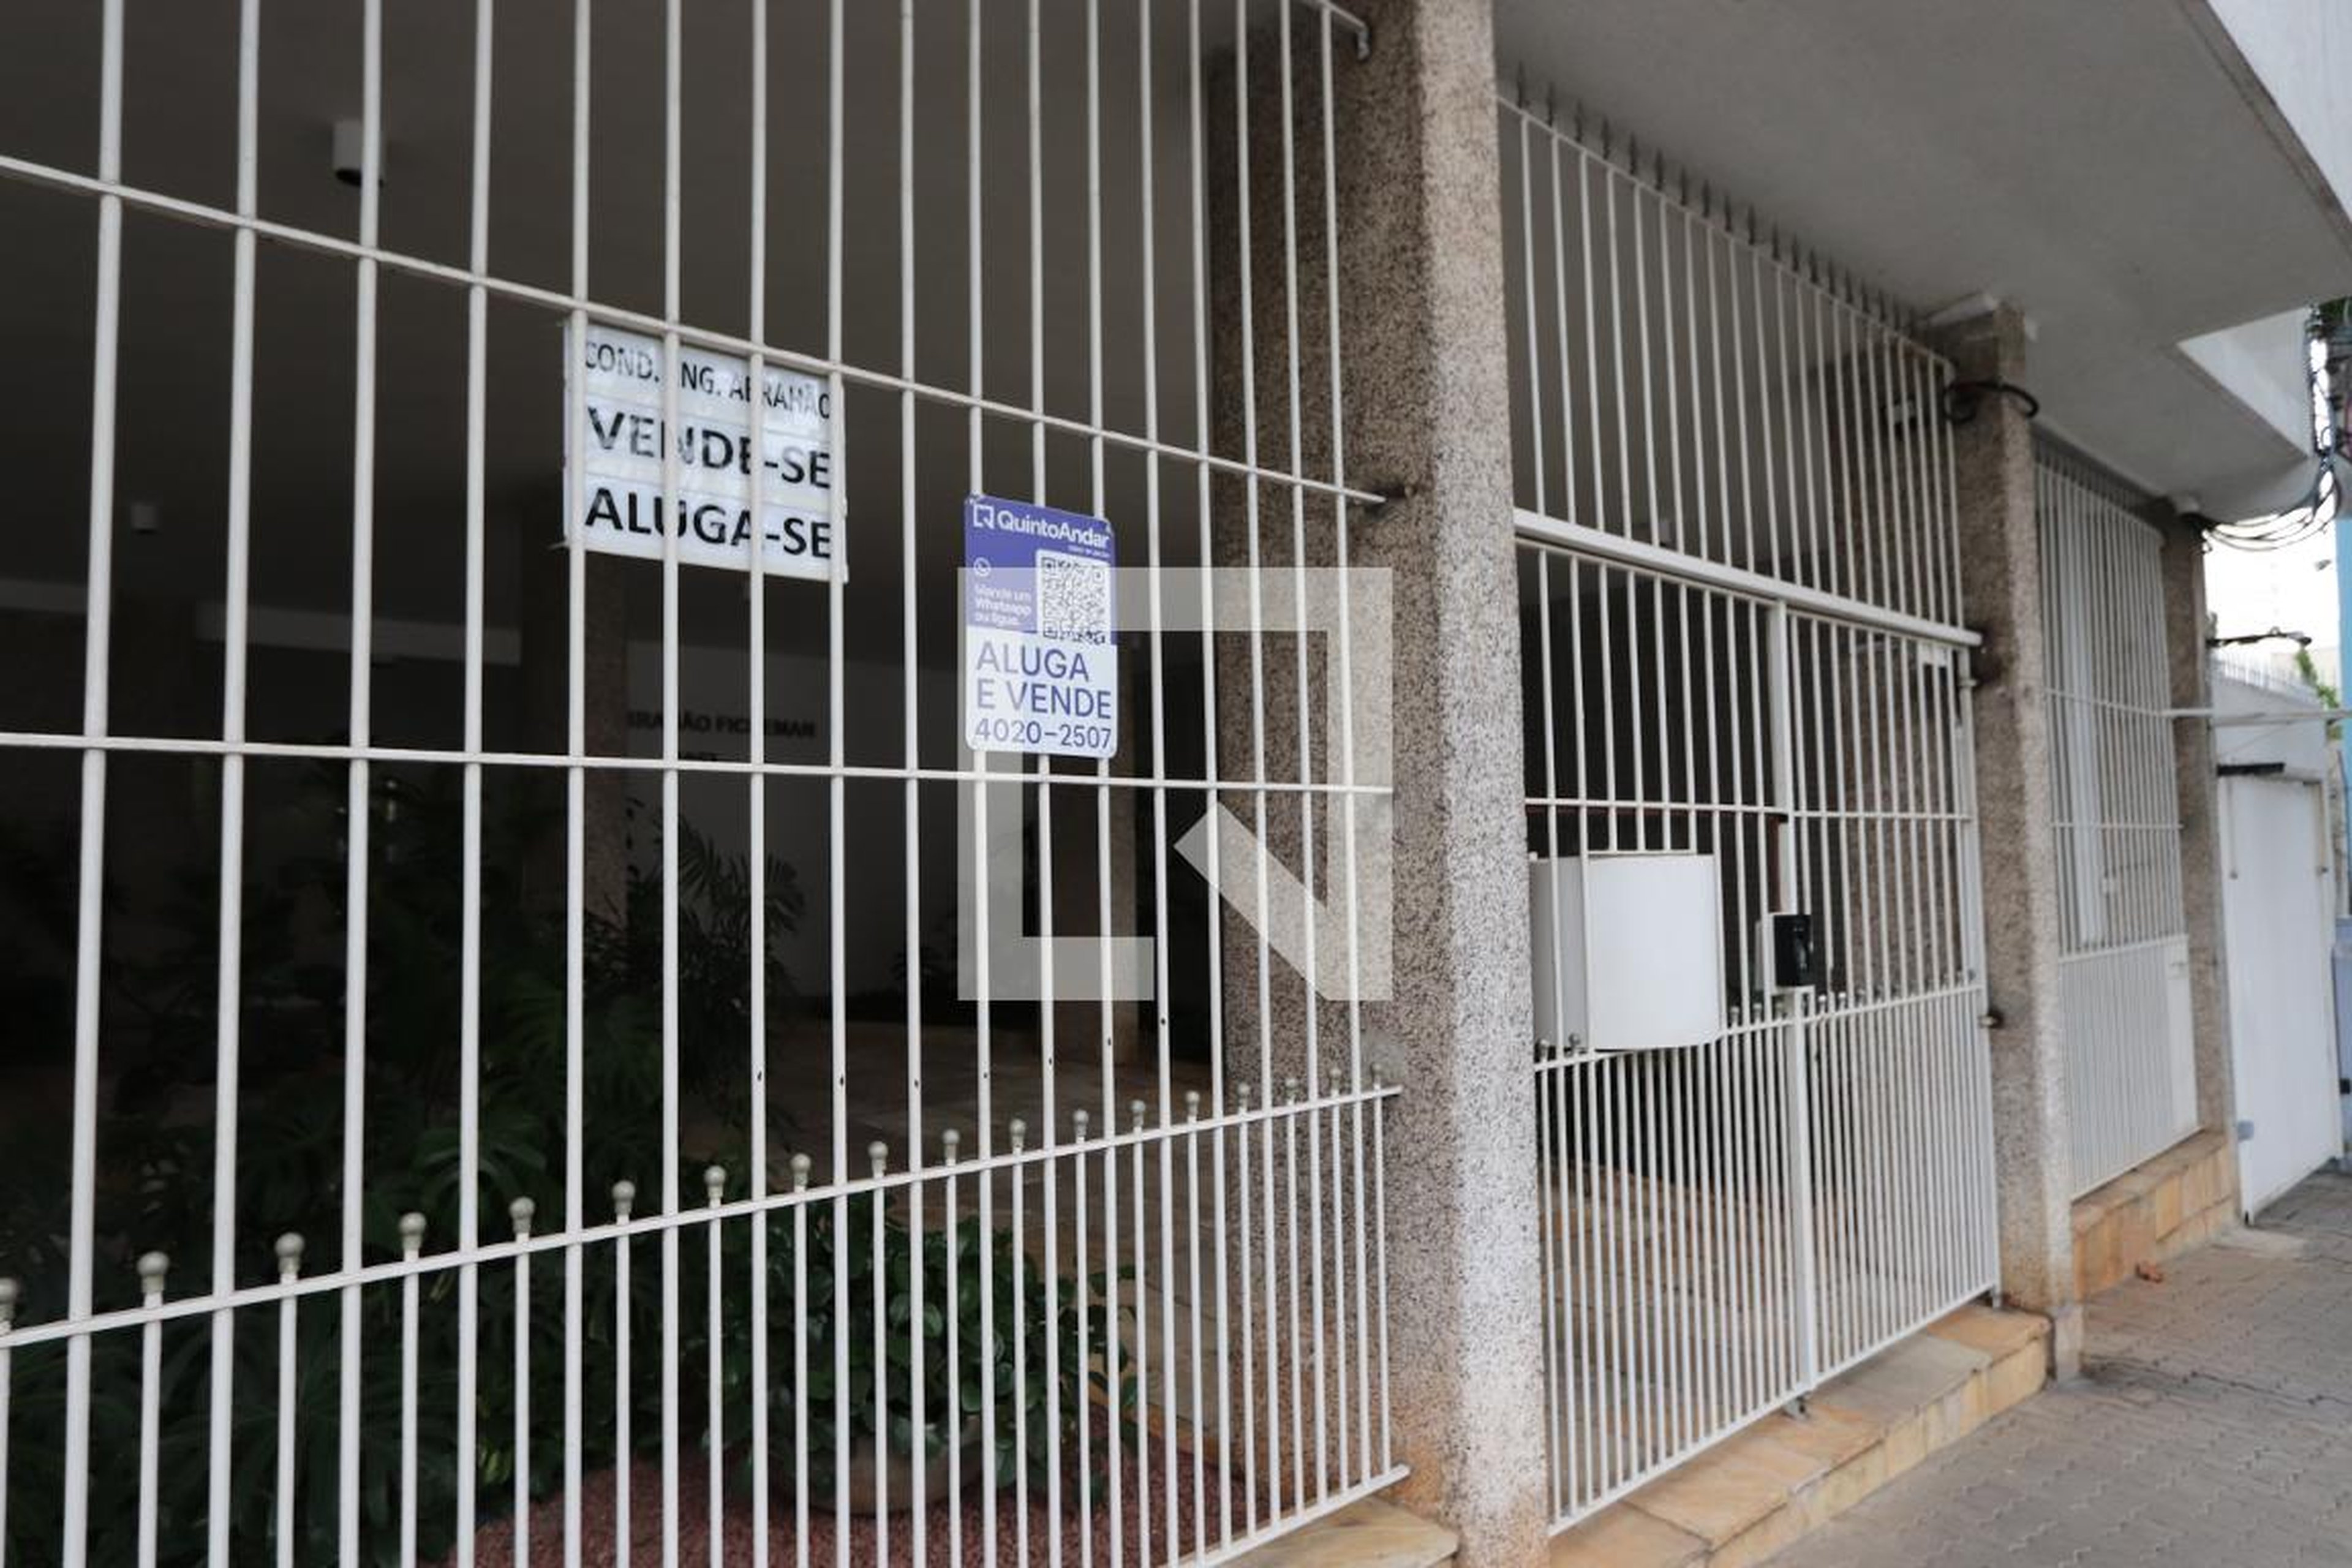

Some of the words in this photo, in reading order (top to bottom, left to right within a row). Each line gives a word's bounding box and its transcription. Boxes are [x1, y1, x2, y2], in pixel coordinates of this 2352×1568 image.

[674, 359, 722, 396] NG.
[587, 406, 831, 489] VENDE-SE
[585, 487, 831, 559] ALUGA-SE
[997, 510, 1110, 549] QuintoAndar
[976, 640, 1090, 682] ALUGA
[977, 678, 995, 710] E
[1006, 680, 1112, 720] VENDE
[974, 717, 1112, 749] 4020-2507
